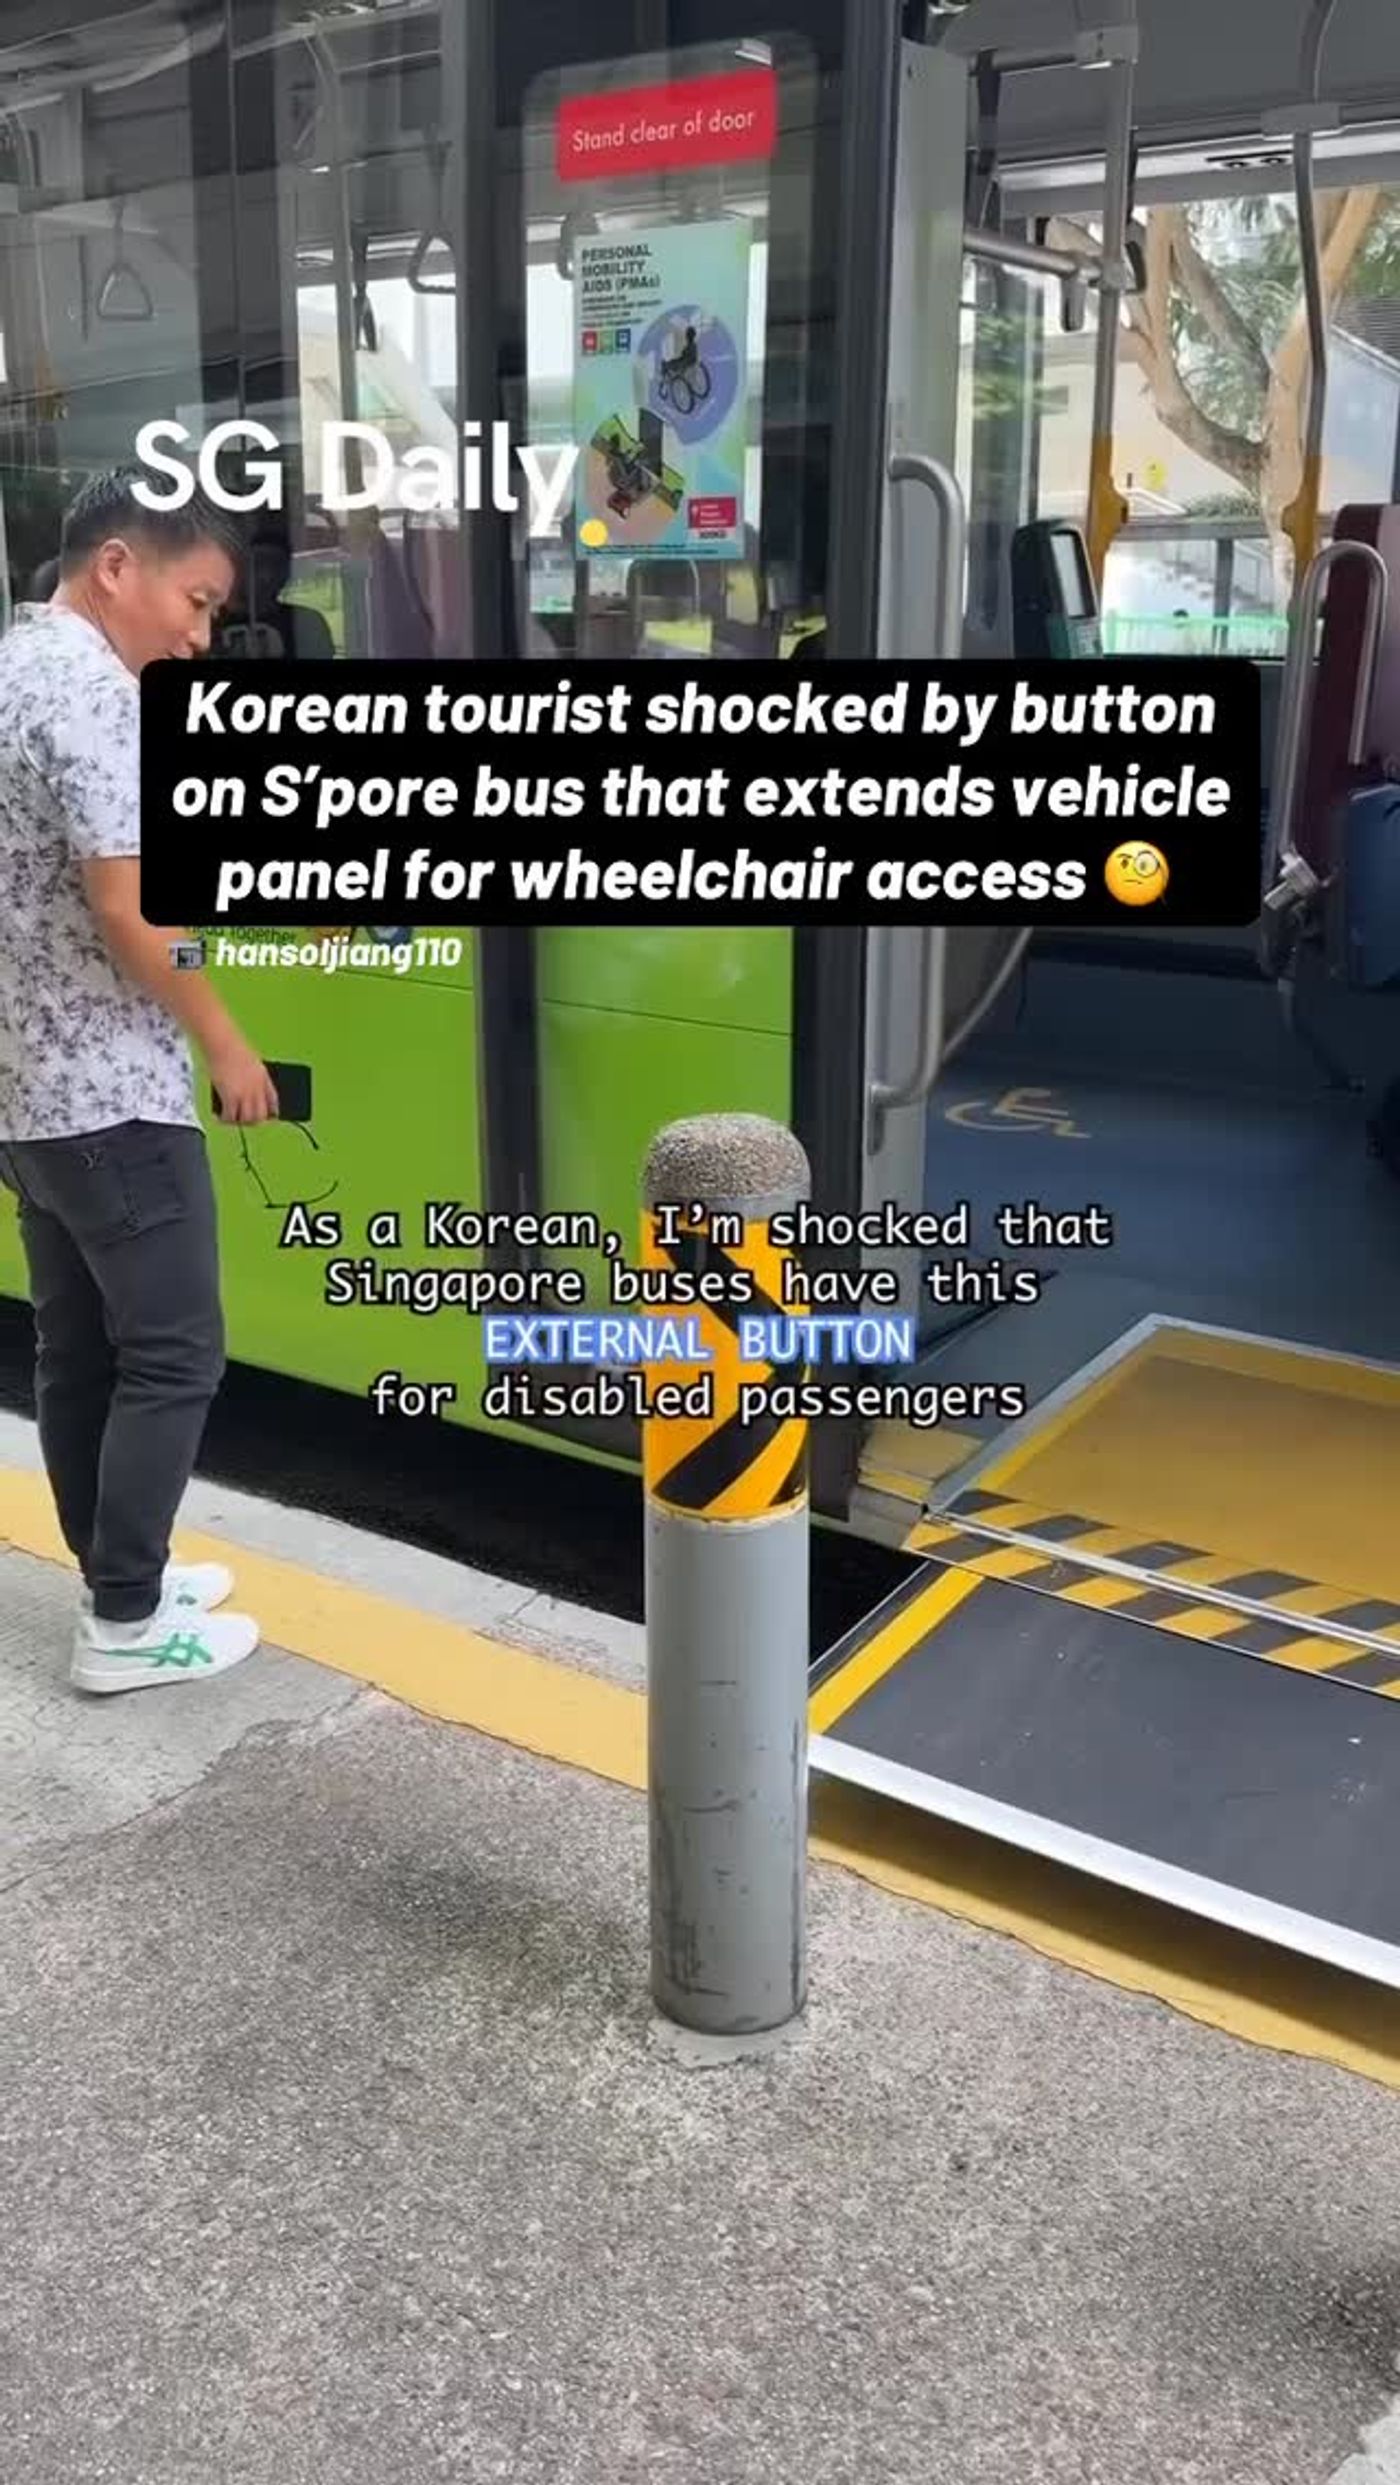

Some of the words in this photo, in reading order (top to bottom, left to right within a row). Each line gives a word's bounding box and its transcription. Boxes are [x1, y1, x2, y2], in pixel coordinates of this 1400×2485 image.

[572, 123, 625, 152] Stand
[630, 119, 678, 144] clear
[683, 110, 702, 136] of
[708, 109, 756, 133] door
[581, 244, 653, 261] PERSONAL
[581, 259, 647, 277] MOBILITY
[582, 279, 612, 293] AIDS
